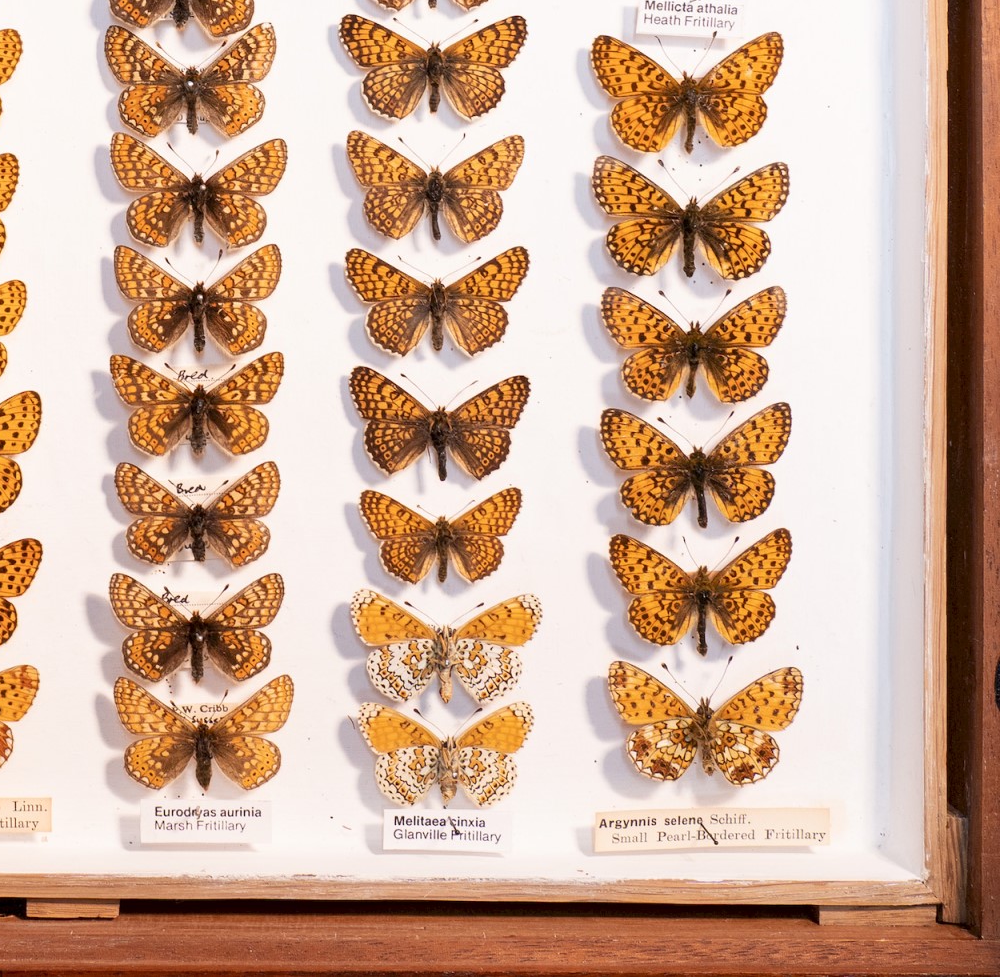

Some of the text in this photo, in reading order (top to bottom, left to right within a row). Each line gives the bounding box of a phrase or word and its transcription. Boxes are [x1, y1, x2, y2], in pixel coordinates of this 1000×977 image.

[644, 0, 738, 15] Mellicta athalia
[643, 13, 735, 31] Heath Fritillary
[200, 704, 229, 713] Cribb
[11, 800, 48, 812] Linn.
[154, 806, 262, 819] Eurodryas aurinia
[154, 820, 246, 833] Marsh Fritillary
[393, 815, 486, 828] Melitaea cinxia
[599, 813, 751, 829] Argynnis selene Schiff.
[393, 828, 502, 844] Glanville Fritillary
[611, 828, 827, 844] Small Pearl-Bordered Fritillary
